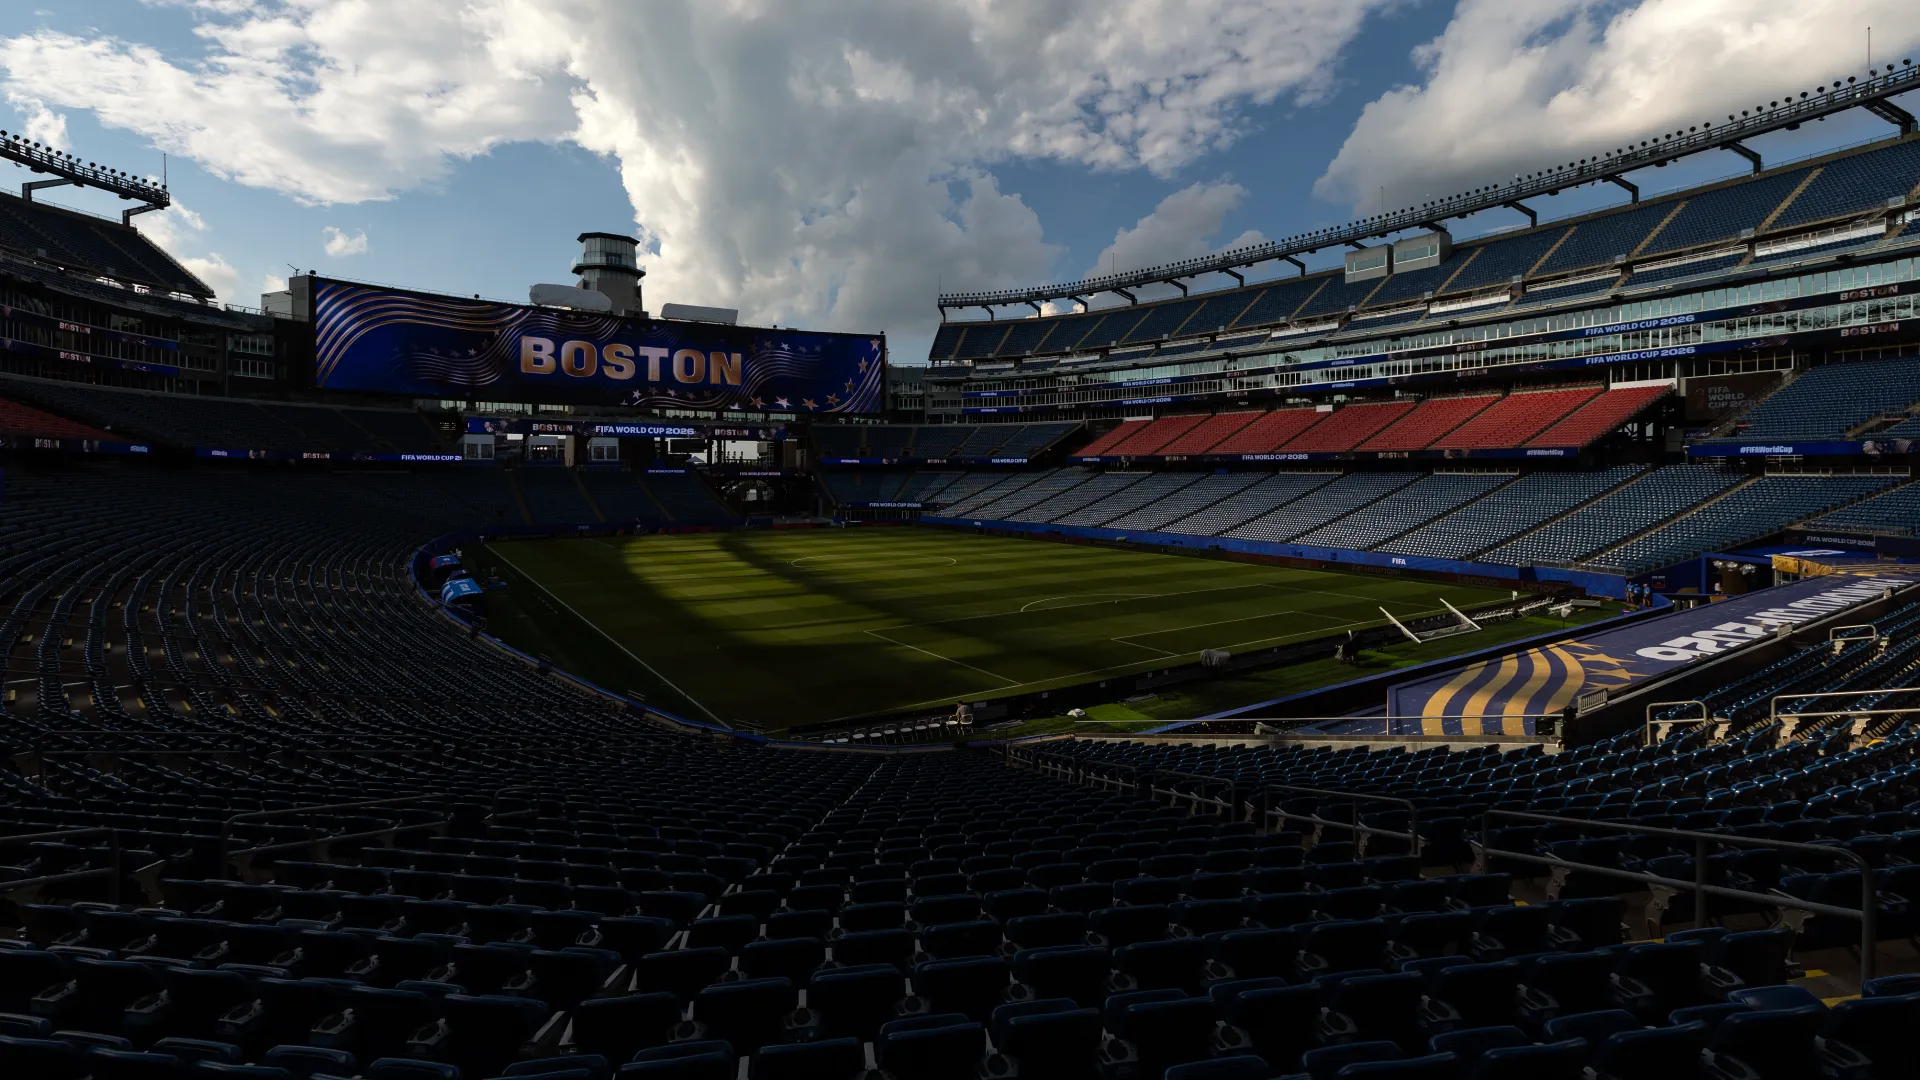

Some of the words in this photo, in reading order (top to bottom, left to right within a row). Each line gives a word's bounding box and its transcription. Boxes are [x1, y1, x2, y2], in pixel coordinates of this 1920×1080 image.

[1840, 285, 1898, 301] BOSTON
[59, 322, 91, 334] BOSTON
[1585, 328, 1604, 336] FIFA
[1605, 322, 1638, 333] WORLD
[1639, 319, 1658, 328] CUP
[1660, 315, 1695, 325] 2026
[1840, 323, 1899, 337] BOSTON
[1456, 343, 1488, 352] BOSTON
[60, 351, 91, 362] BOSTON
[1586, 356, 1605, 364] FIFA
[1606, 352, 1638, 362] WORLD
[1640, 349, 1659, 358] CUP
[1661, 346, 1696, 356] 2026
[520, 335, 742, 385] BOSTON
[1456, 369, 1488, 378] BOSTON
[1708, 386, 1729, 394] FIFA
[1708, 393, 1745, 401] WORLD
[1708, 401, 1728, 409] CUP
[532, 423, 573, 432] BOSTON
[615, 426, 647, 434] WORLD
[35, 439, 60, 448] BOSTON
[1739, 446, 1793, 454] #FIFAWorldCup
[1857, 539, 1876, 547] 2026
[1391, 557, 1406, 565] FIFA
[1457, 575, 1500, 587] Lenovo
[1635, 621, 1769, 662] 2026
